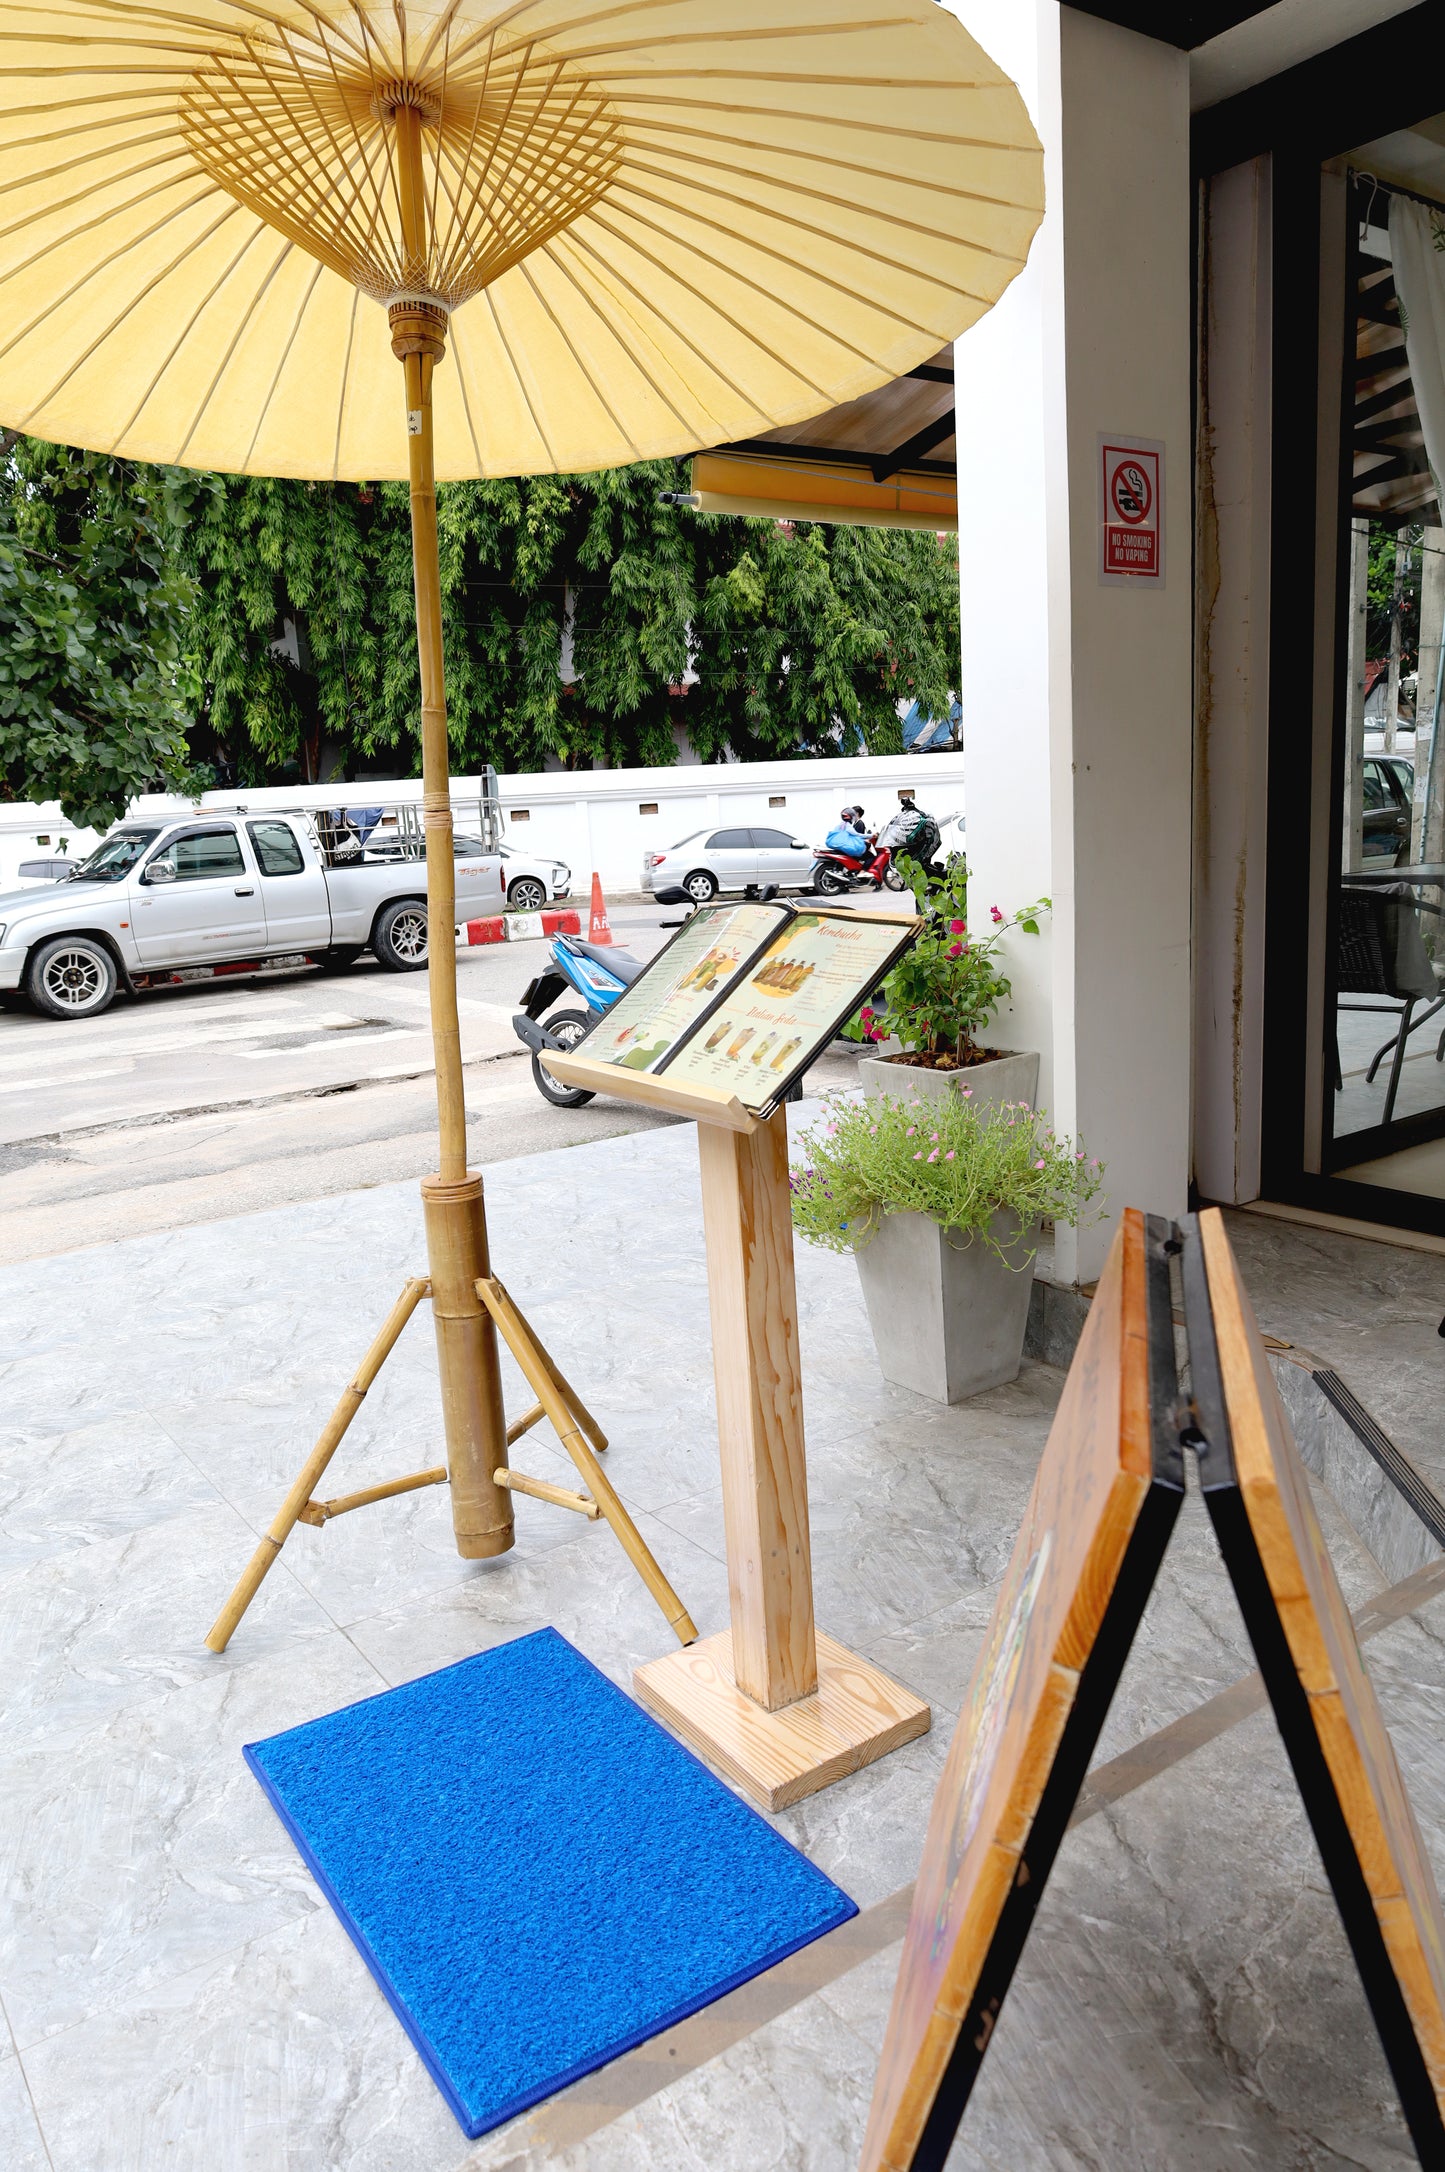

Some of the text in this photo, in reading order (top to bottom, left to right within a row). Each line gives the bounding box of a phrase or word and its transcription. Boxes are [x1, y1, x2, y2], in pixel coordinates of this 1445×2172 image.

[1112, 533, 1152, 548] NO SMOKING
[1115, 547, 1149, 562] NO VAPING
[745, 1006, 775, 1021] Italian
